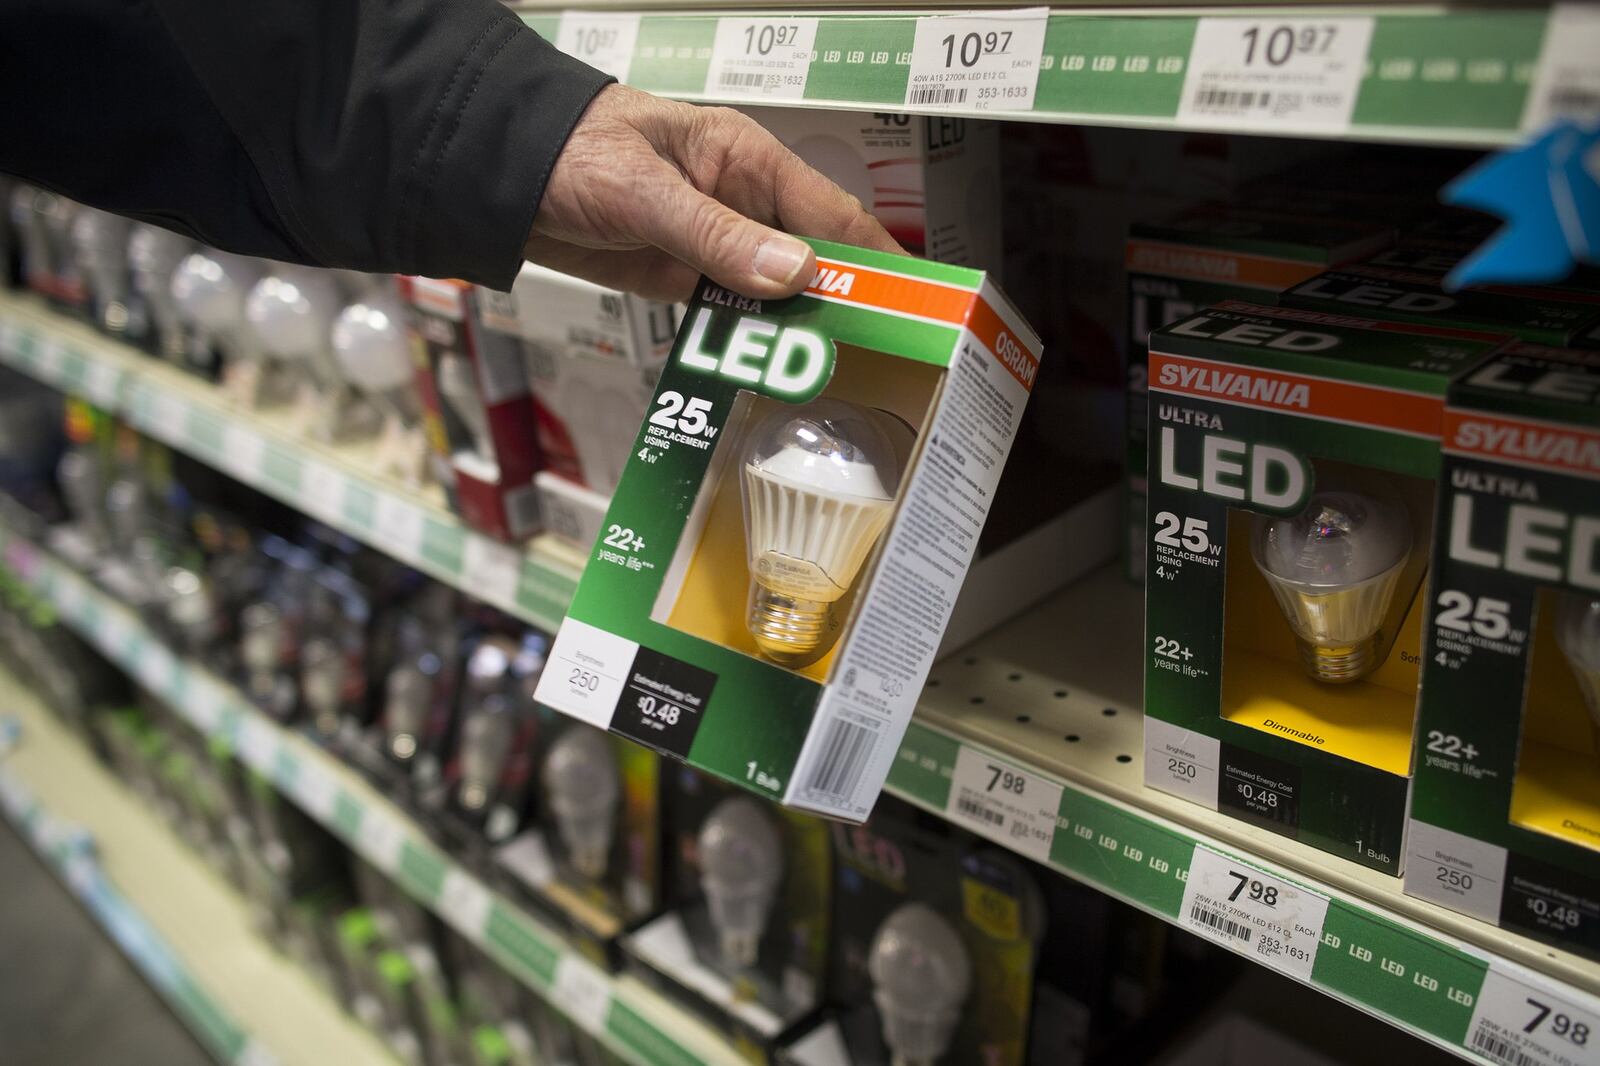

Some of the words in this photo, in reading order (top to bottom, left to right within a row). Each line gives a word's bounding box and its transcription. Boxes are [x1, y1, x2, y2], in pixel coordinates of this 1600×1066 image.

[824, 51, 841, 63] LED
[847, 51, 864, 63] LED
[871, 52, 889, 64] LED
[1040, 55, 1054, 70] ED
[1061, 55, 1085, 71] LED
[1092, 56, 1117, 72] LED
[1123, 56, 1149, 73] LED
[930, 74, 943, 82] A15
[945, 73, 966, 81] 2700K
[968, 73, 982, 81] LED
[983, 72, 996, 80] E12
[977, 87, 1028, 99] 353-1633
[702, 286, 762, 314] ULTRA
[1294, 278, 1456, 313] LED
[1169, 316, 1341, 351] LED
[680, 307, 827, 393] LED
[995, 331, 1036, 386] OSRAM
[1159, 363, 1311, 409] SYLVANIA
[1159, 404, 1224, 431] ULTRA
[643, 435, 671, 450] USING
[647, 425, 711, 450] REPLACEMENT
[1161, 426, 1305, 508] LED
[1450, 468, 1539, 501] ULTRA
[603, 524, 646, 552] 22+
[597, 549, 625, 566] years
[1156, 545, 1220, 568] REPLACEMENT
[1156, 554, 1182, 567] USING
[1154, 636, 1193, 661] 22+
[1401, 651, 1421, 665] Sof
[1154, 657, 1180, 672] years
[568, 668, 600, 692] 250
[637, 696, 681, 726] $0.48
[1263, 719, 1325, 745] Dimmable
[1166, 743, 1196, 759] Brightness
[1426, 730, 1480, 760] 22+
[747, 760, 757, 780] 1
[1168, 758, 1197, 778] 250
[1425, 754, 1460, 773] years
[1226, 765, 1256, 781] Estimated
[1256, 773, 1277, 789] Energy
[1278, 781, 1293, 793] Cost
[1237, 783, 1278, 807] $0.48
[1055, 816, 1069, 830] ED
[1074, 823, 1093, 840] LED
[1099, 834, 1117, 851] LED
[1123, 845, 1143, 862] LED
[1149, 856, 1169, 874] LED
[1176, 867, 1189, 883] LE
[1355, 840, 1363, 854] 1
[1367, 848, 1391, 864] Bulb
[1435, 851, 1473, 869] Brightness
[1436, 866, 1473, 890] 250
[1212, 900, 1227, 911] A15
[1228, 906, 1251, 922] 2700K
[1252, 917, 1267, 928] LED
[1267, 923, 1282, 933] E12
[1283, 928, 1293, 939] CL
[1526, 898, 1581, 928] $0.48
[1294, 923, 1316, 938] EACH
[1259, 934, 1310, 962] 353-1631
[1349, 943, 1372, 962] LED
[1380, 957, 1405, 977] LED
[1413, 971, 1439, 992] LED
[1447, 986, 1473, 1008] LED
